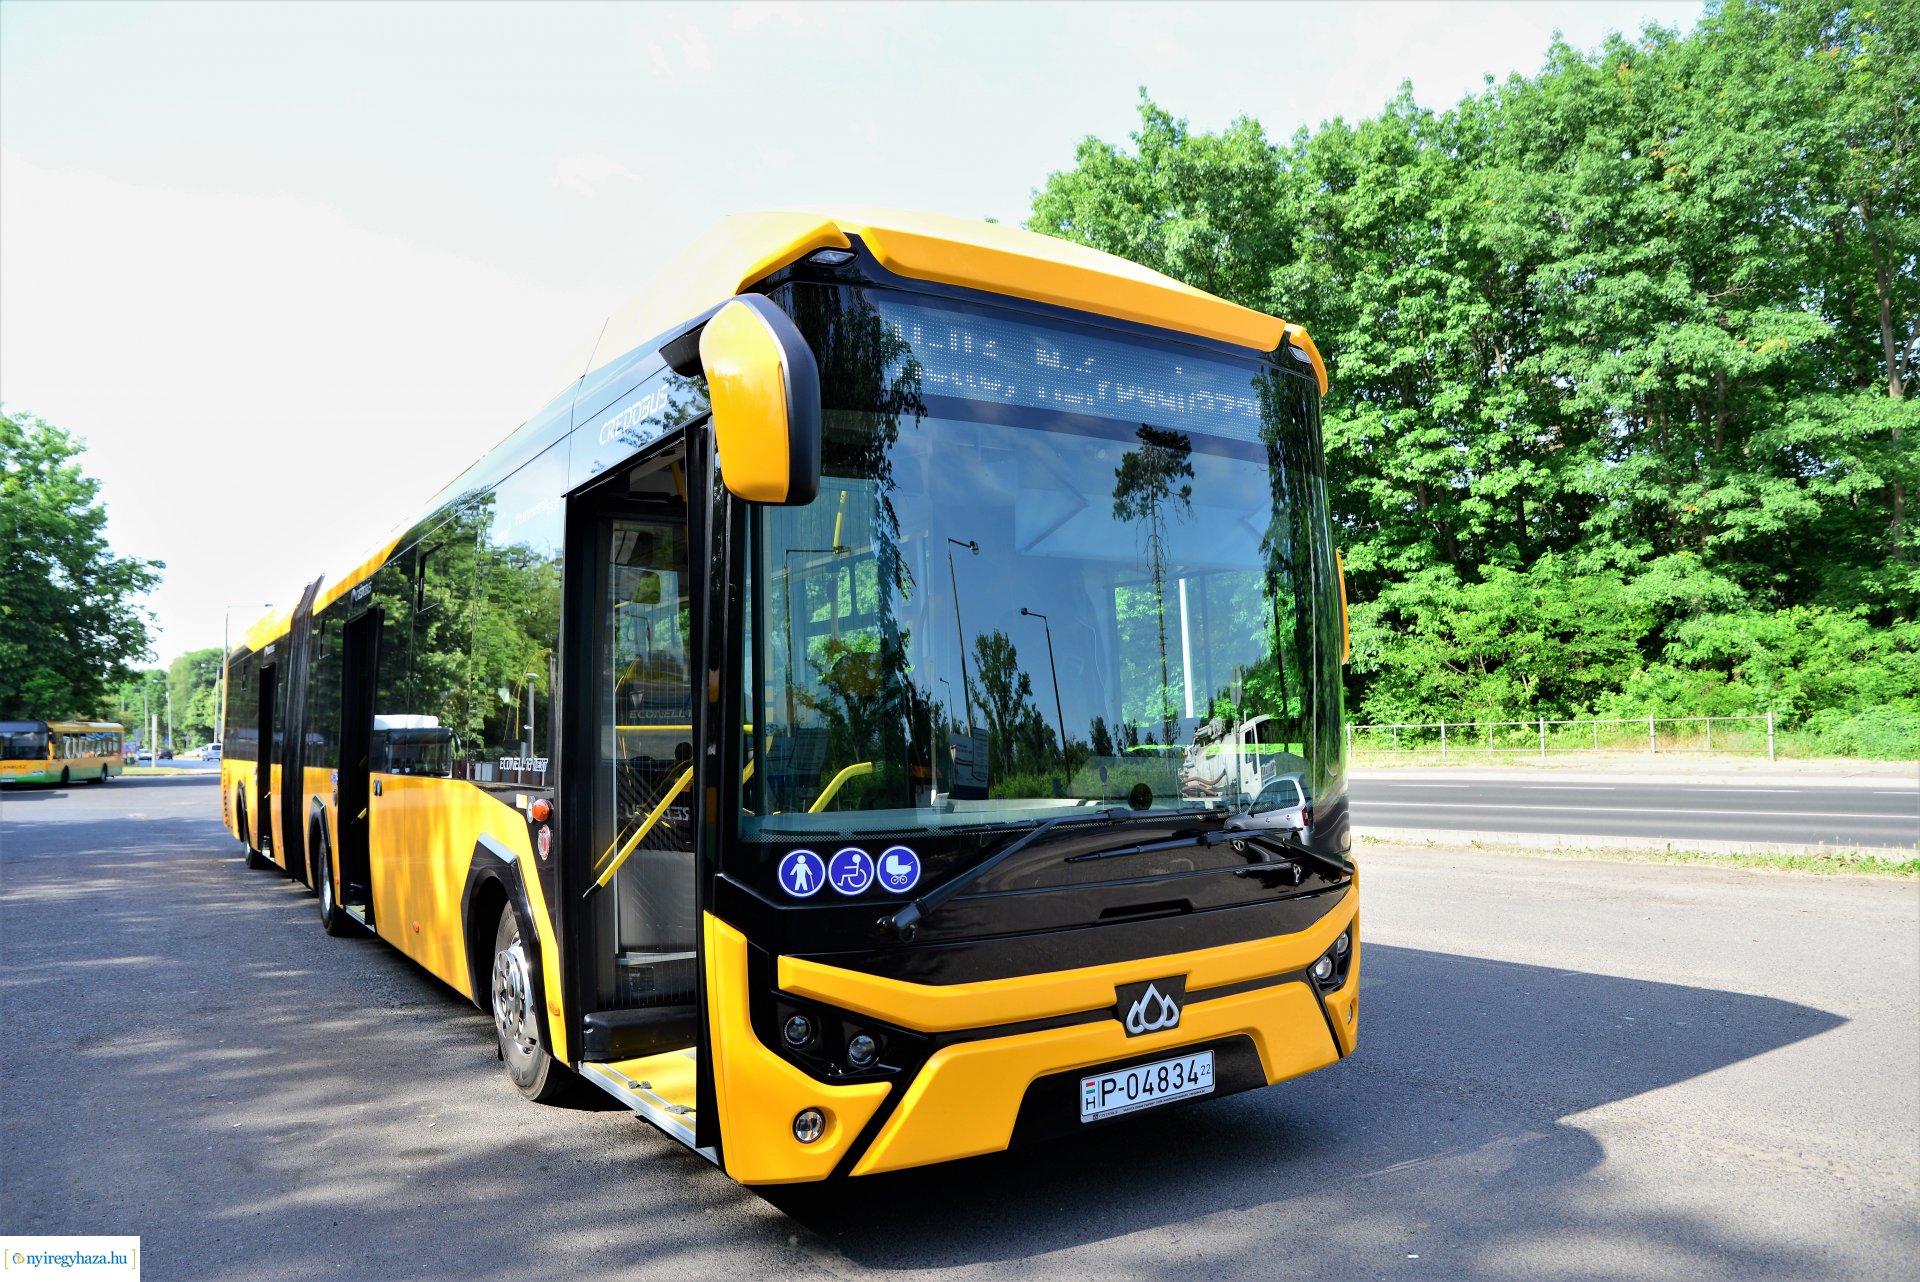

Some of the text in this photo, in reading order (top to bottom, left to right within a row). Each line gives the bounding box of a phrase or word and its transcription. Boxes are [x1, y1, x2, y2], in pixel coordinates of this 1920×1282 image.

[599, 383, 669, 445] CREDOBUS
[1085, 1096, 1096, 1111] H
[1101, 1059, 1199, 1107] P-04834
[1200, 1063, 1211, 1076] 22
